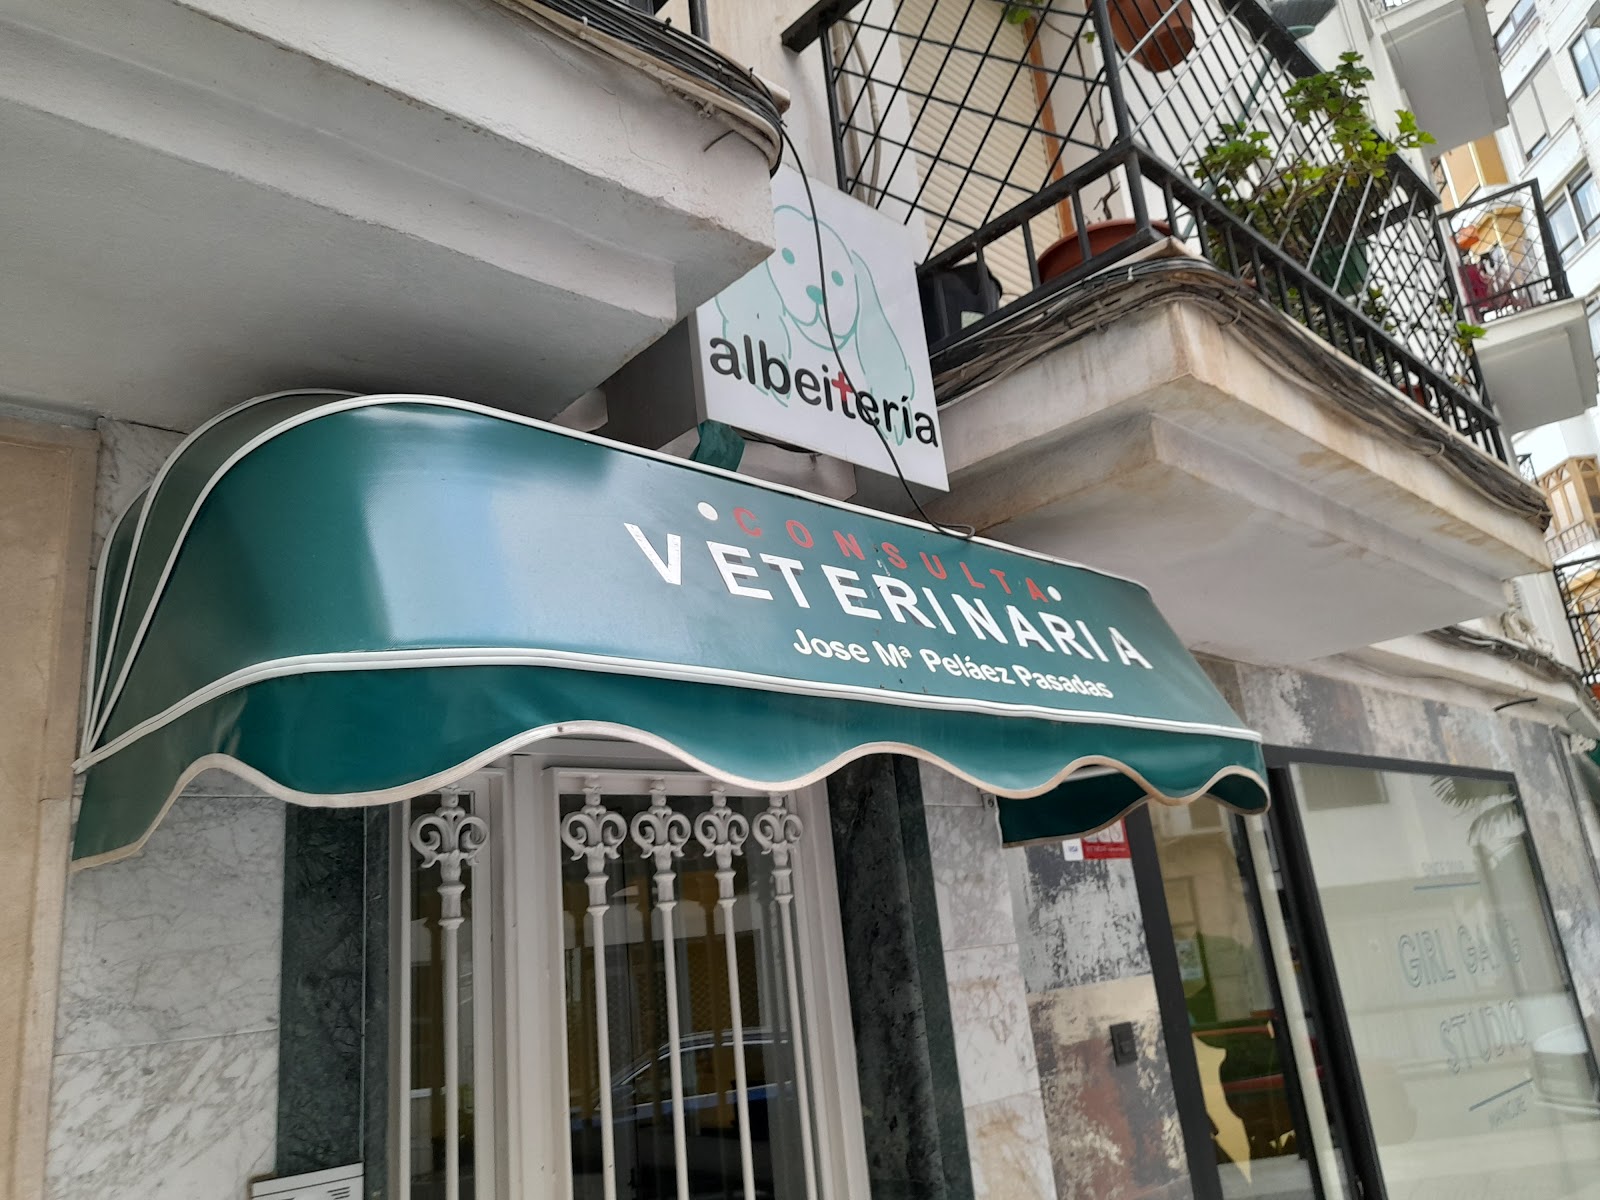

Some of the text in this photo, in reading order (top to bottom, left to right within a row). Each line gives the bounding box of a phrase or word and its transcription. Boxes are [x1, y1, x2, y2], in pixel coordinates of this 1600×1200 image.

[709, 334, 939, 448] albeitería
[624, 522, 1153, 669] VETERINARIA
[733, 507, 1049, 601] CONSULTA
[793, 629, 870, 664] Jose
[919, 648, 1016, 685] Peláez
[1011, 664, 1114, 699] Pasadas
[1398, 929, 1456, 988] GIRL
[1440, 999, 1527, 1075] STUDIO
